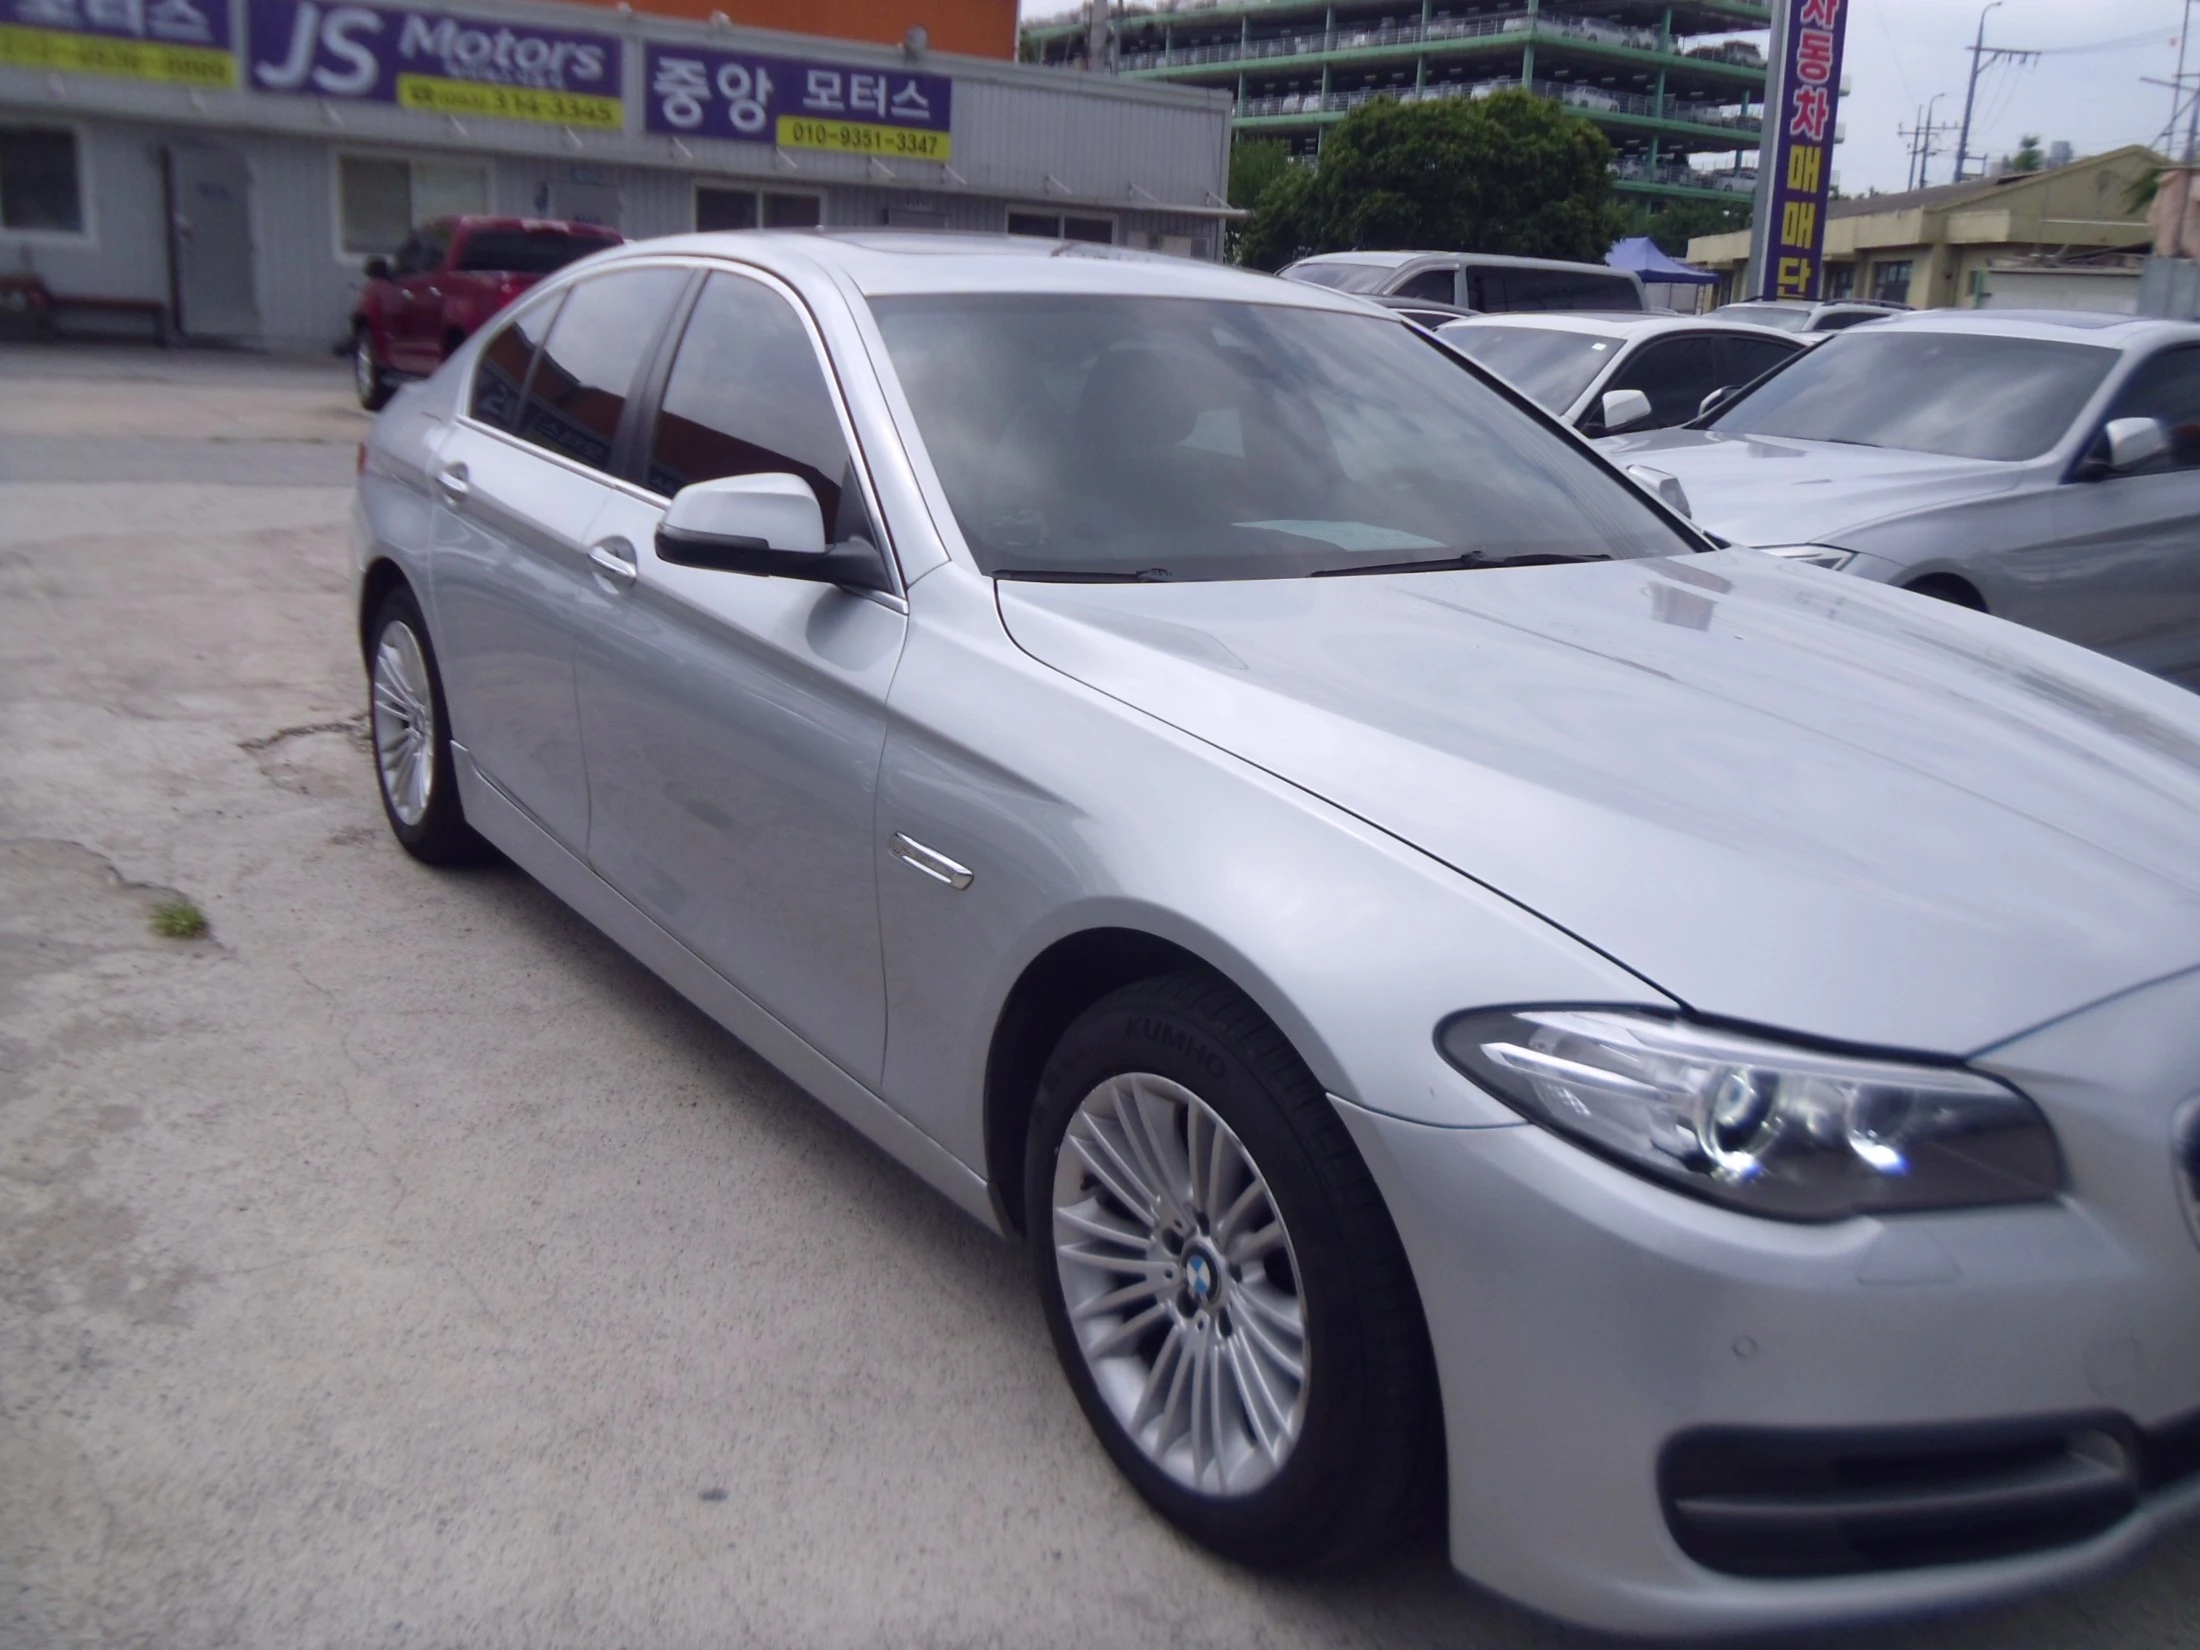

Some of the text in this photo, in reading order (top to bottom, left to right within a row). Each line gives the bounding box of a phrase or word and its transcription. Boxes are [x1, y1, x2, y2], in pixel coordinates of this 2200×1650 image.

[255, 3, 383, 94] JS
[399, 14, 605, 80] Motors
[654, 57, 930, 133] 중앙 모터스
[792, 121, 937, 155] 010-9351-3347
[1125, 1016, 1227, 1079] KUMHO
